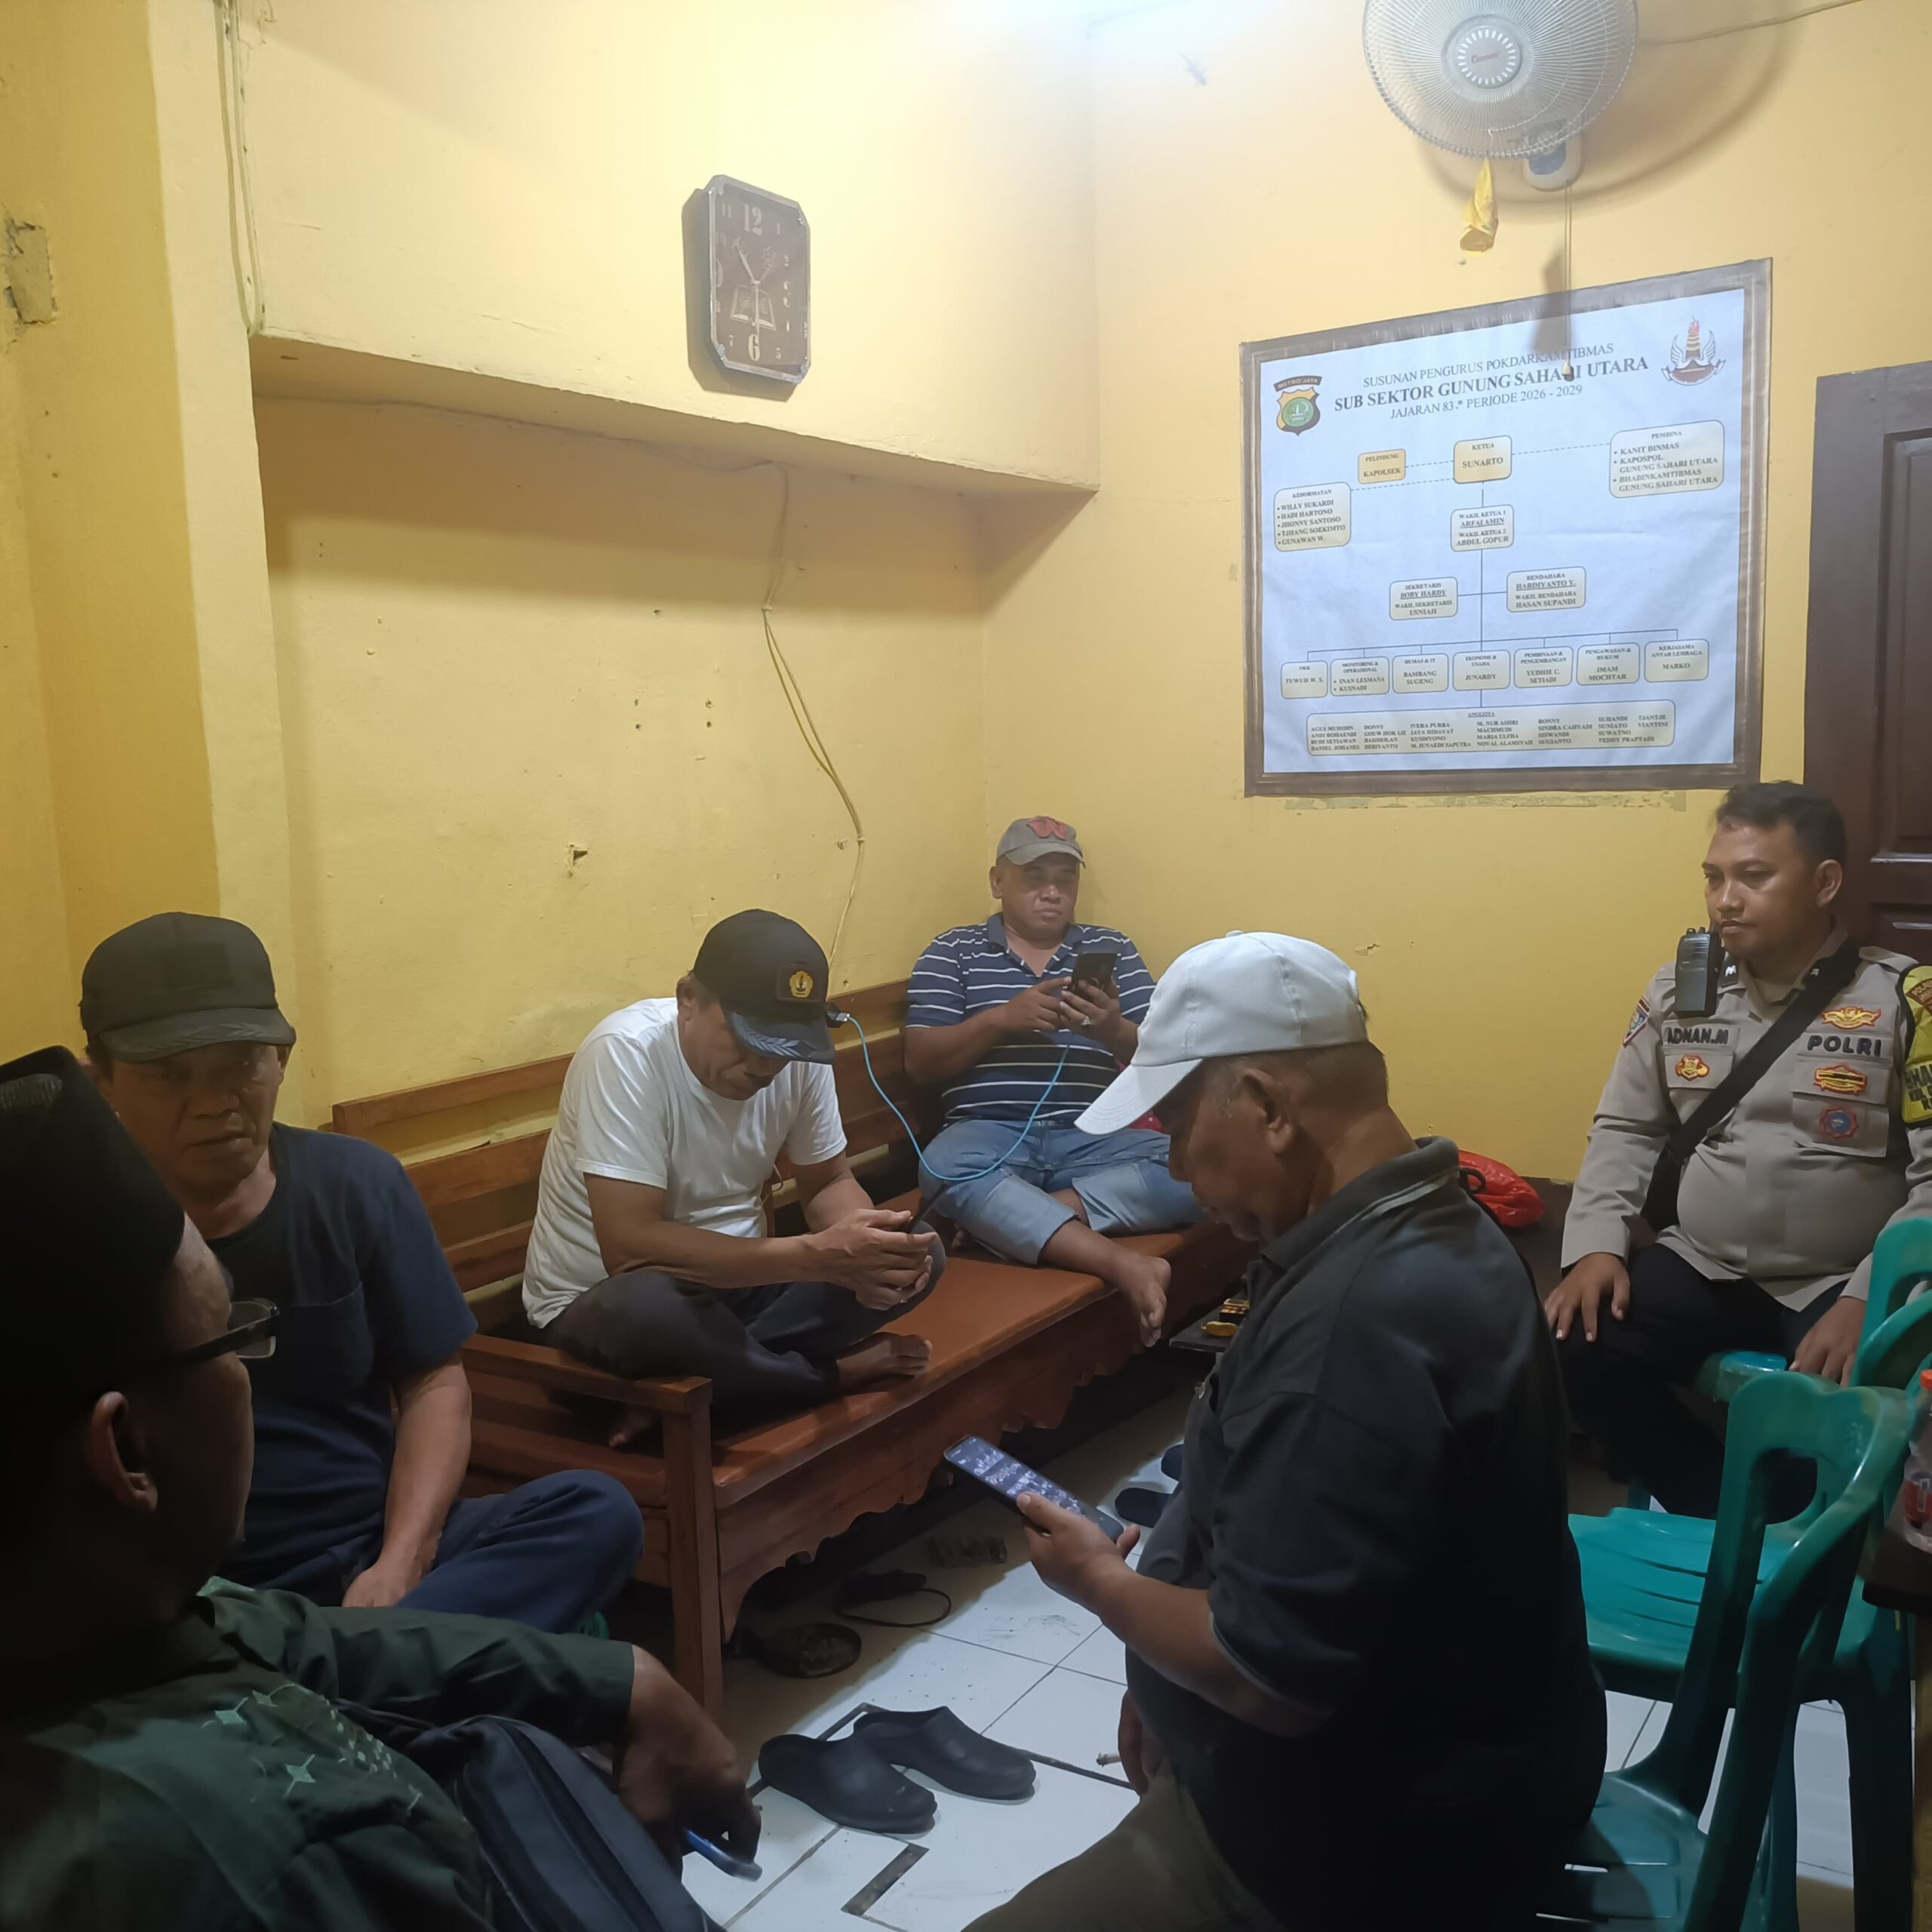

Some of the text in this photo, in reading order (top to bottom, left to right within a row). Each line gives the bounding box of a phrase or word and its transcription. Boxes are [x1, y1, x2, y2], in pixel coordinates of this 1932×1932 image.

[743, 203, 762, 236] 12
[747, 334, 761, 361] 6
[1363, 343, 1614, 388] SUSUNAN PENGURUS POKDARKAMTIBMAS
[1334, 356, 1648, 411] SUB SEKTOR GUNUNG SAHAI UTARA
[1390, 402, 1440, 419] JAJARAN
[1466, 392, 1518, 408] PERIODE
[1520, 388, 1546, 401] 2026
[1556, 384, 1583, 398] 2029
[1651, 431, 1682, 439] PEMBINA
[1472, 442, 1494, 451] KETUA
[1620, 442, 1679, 455] KANIT BINMAS
[1365, 454, 1399, 462] PELINDUNG
[1462, 457, 1503, 469] SUNARTO
[1620, 454, 1663, 465] KAPOSPOL
[1620, 457, 1718, 474] GUNUNG SAHARI UTARA
[1363, 467, 1401, 478] KAPOLSEK
[1619, 476, 1718, 492] GUNUNG SAHARI UTARA
[1292, 489, 1332, 498] KEHORMATAN
[1281, 500, 1334, 511] WILLY SUKARDI
[1281, 508, 1333, 520] HADI HARTONO
[1309, 516, 1341, 526] SANTOSO
[1281, 536, 1316, 546] GUNAWAN
[1457, 536, 1509, 546] ABDUL GOPUR
[1526, 573, 1565, 581] BENDAHARA
[1516, 580, 1567, 589] HARDIYANTO
[1400, 591, 1419, 599] BOBY
[1516, 598, 1576, 609] HASAN SUPANDI
[1806, 1035, 1883, 1057] POLRI
